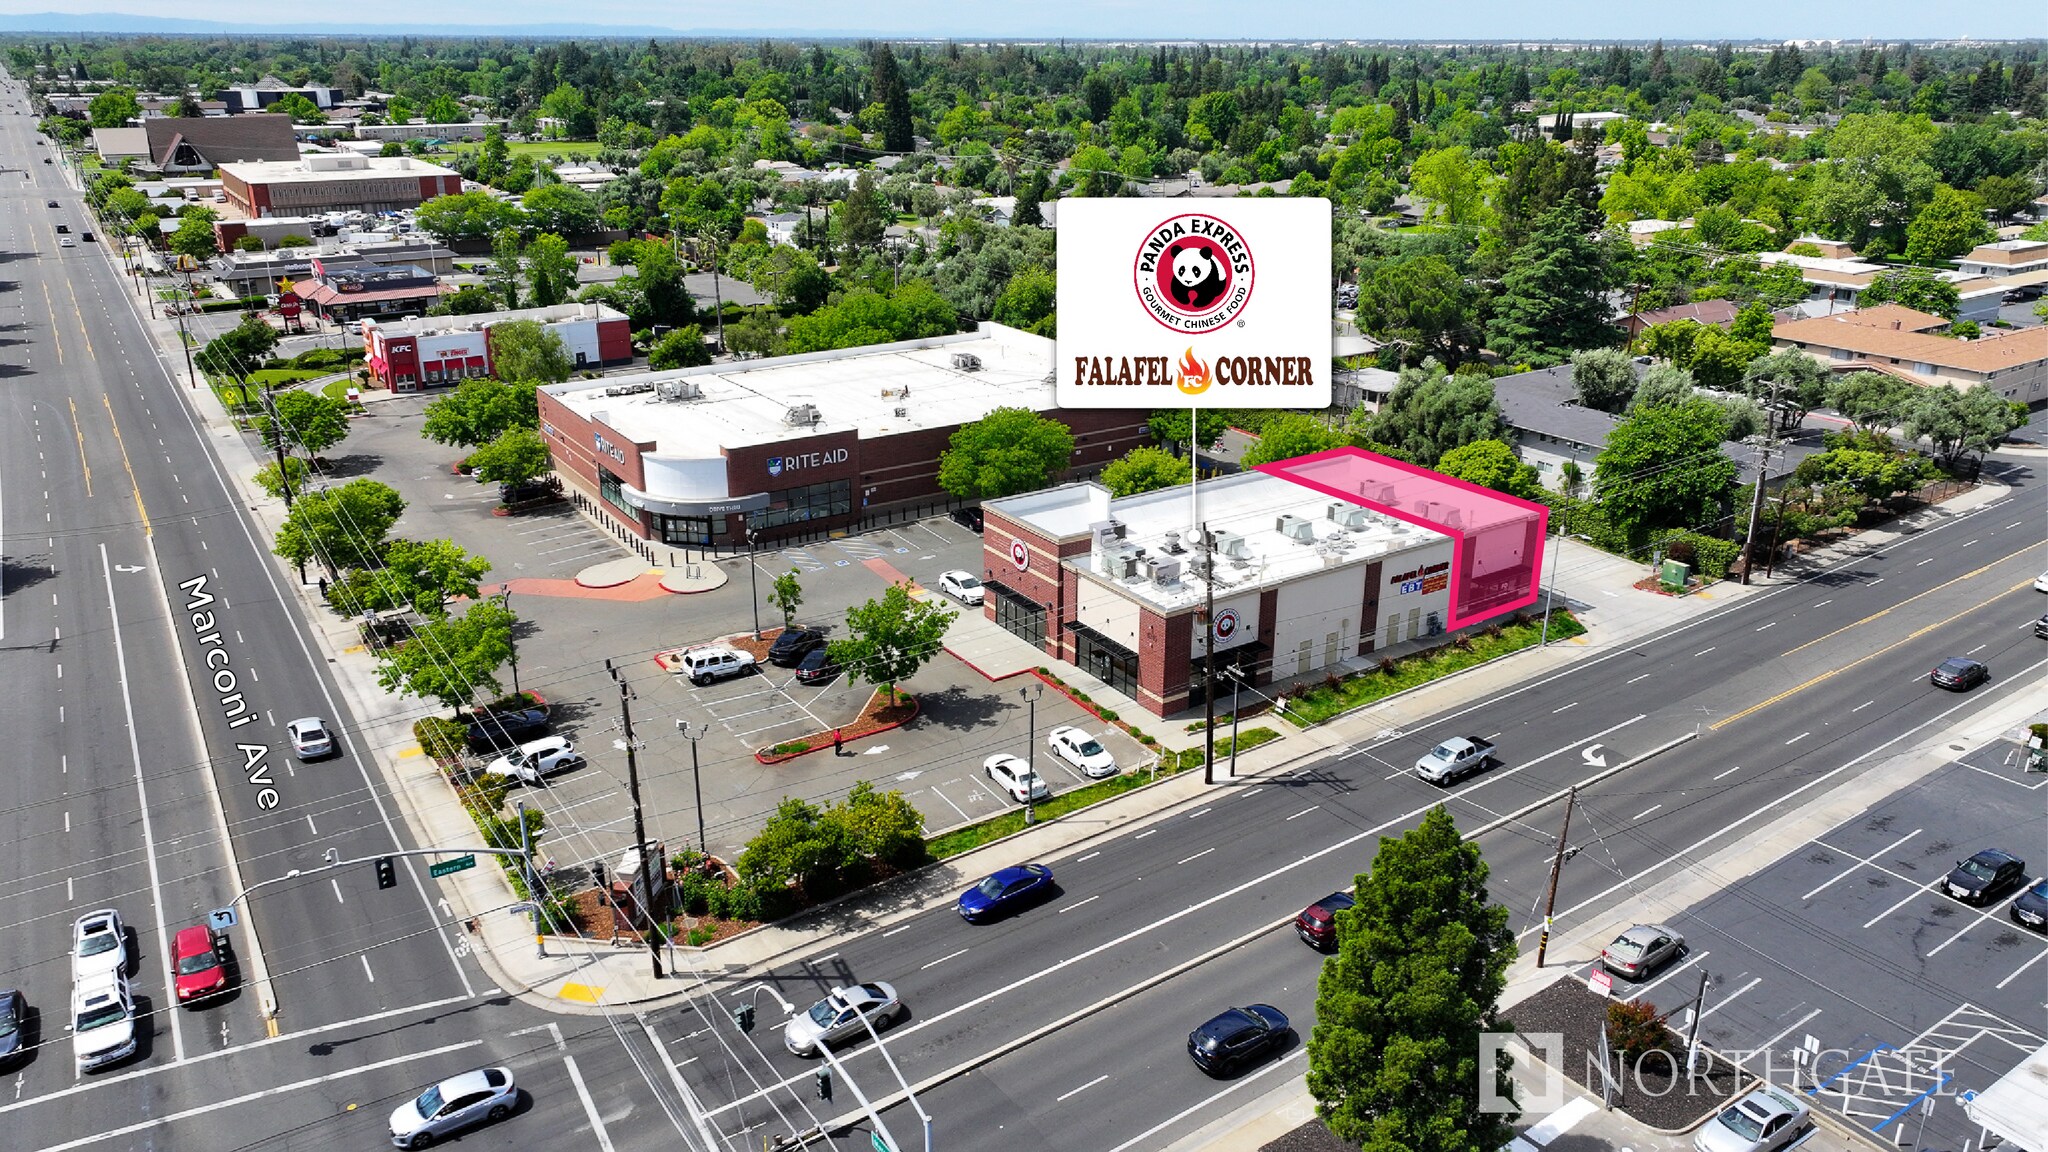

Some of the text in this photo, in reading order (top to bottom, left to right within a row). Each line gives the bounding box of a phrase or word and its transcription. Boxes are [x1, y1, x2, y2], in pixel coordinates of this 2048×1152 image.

[391, 345, 412, 354] KFC
[785, 448, 849, 472] RITE AID
[1401, 581, 1422, 594] EBT
[433, 864, 462, 876] Eastern
